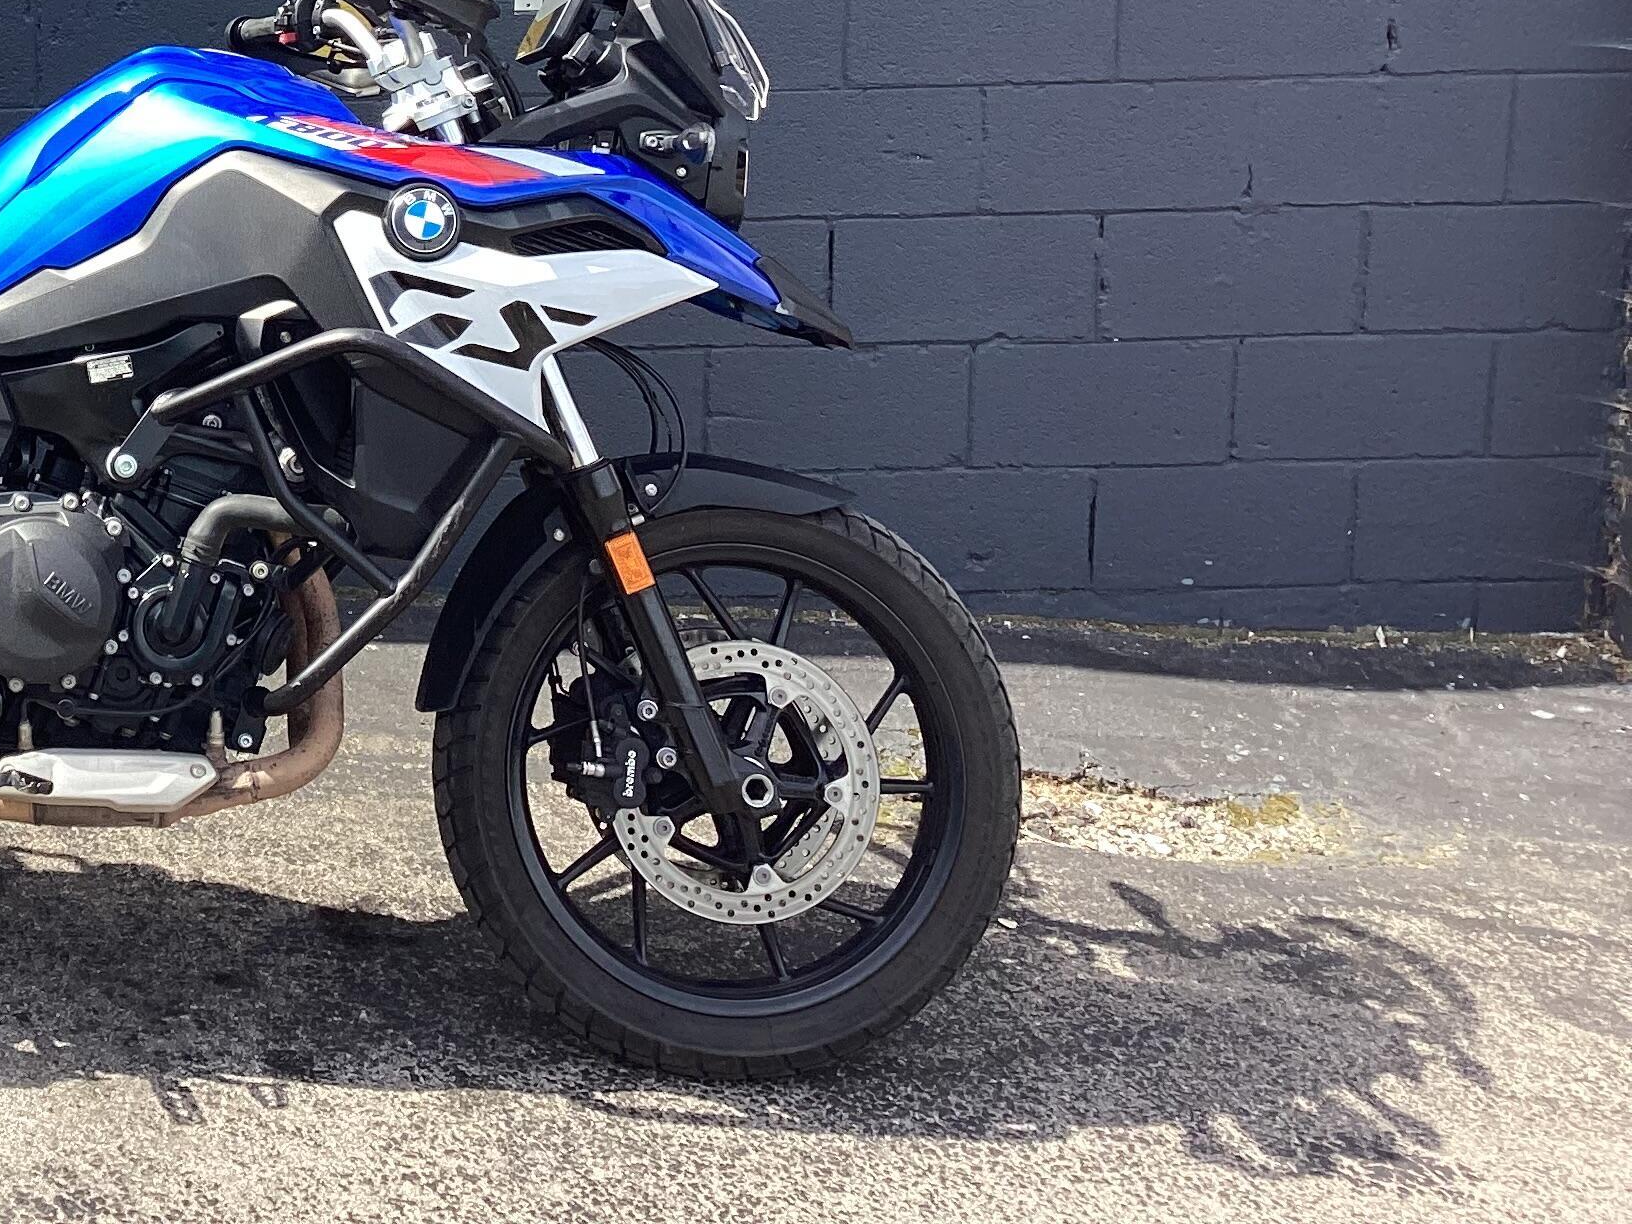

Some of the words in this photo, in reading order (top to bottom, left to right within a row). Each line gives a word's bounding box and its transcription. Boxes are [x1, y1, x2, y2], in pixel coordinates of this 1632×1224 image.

[402, 190, 455, 216] BMW
[43, 571, 93, 616] BMW
[622, 750, 637, 797] brembo
